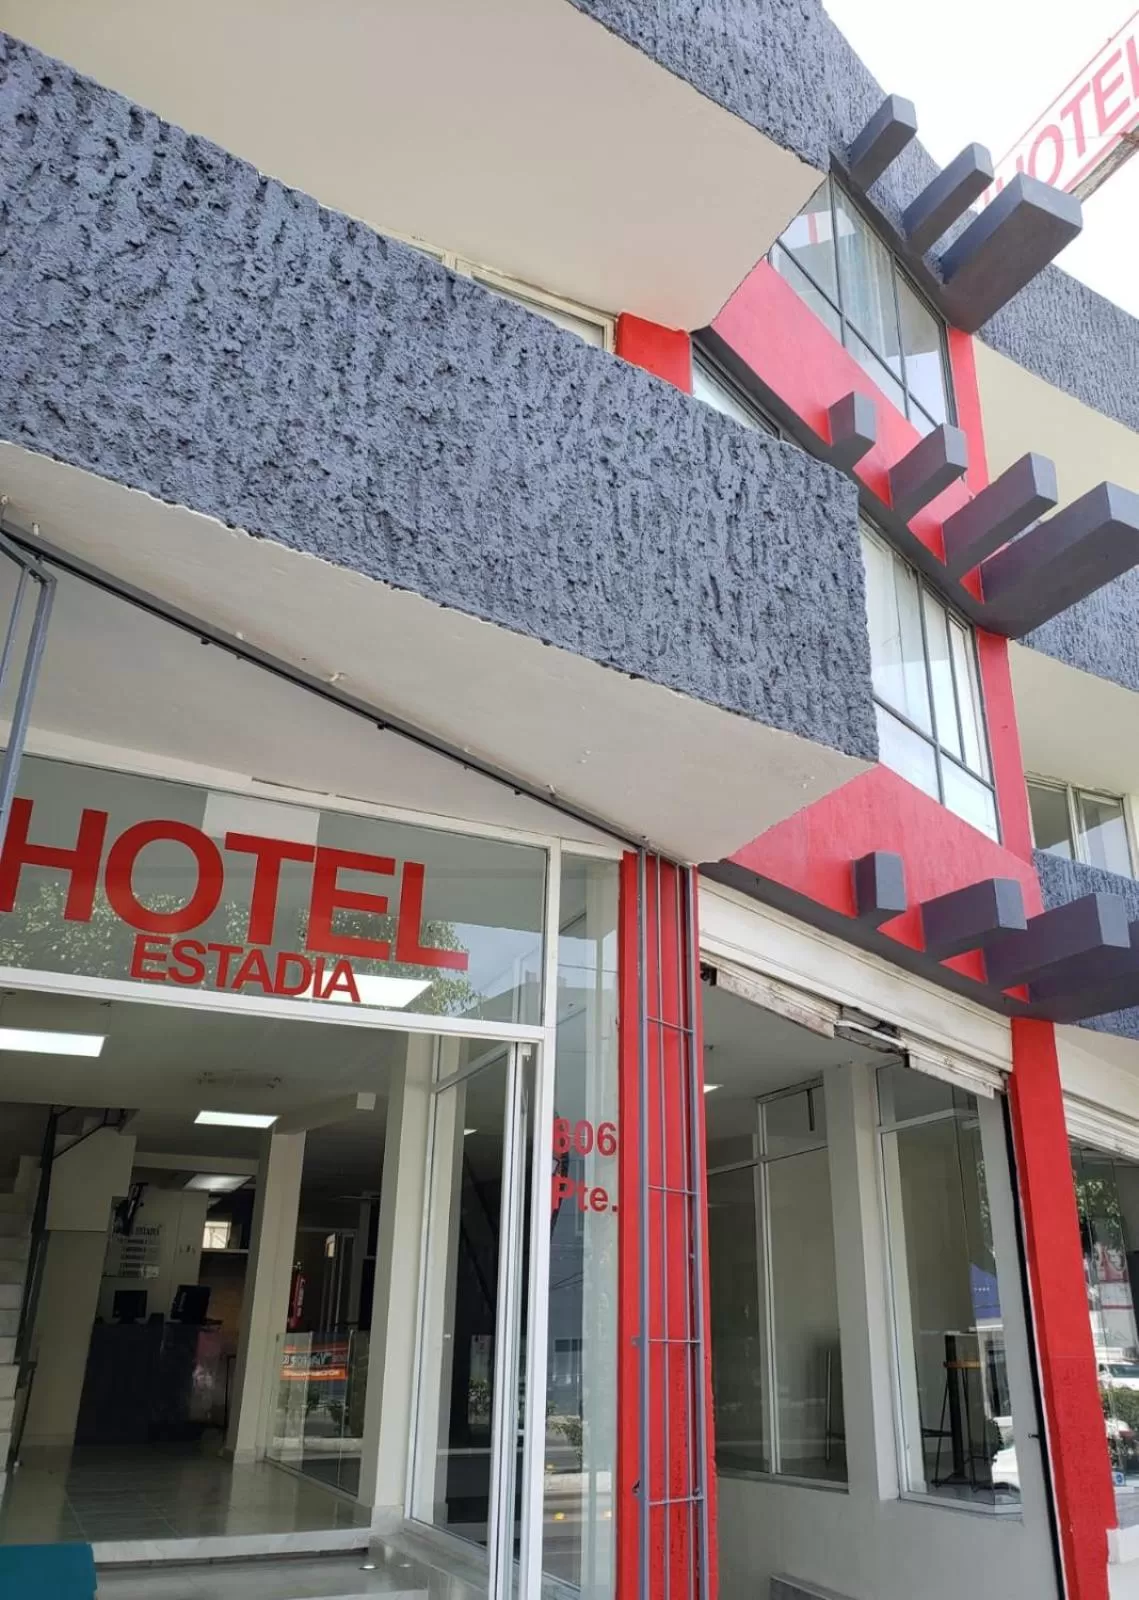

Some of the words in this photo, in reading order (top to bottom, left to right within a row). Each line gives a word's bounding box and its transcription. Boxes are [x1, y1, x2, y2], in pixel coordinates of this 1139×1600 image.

[995, 35, 1139, 193] OTE
[0, 797, 468, 971] HOTEL
[130, 934, 361, 1003] ESTADIA
[553, 1117, 617, 1156] 806
[551, 1175, 619, 1211] Pte.
